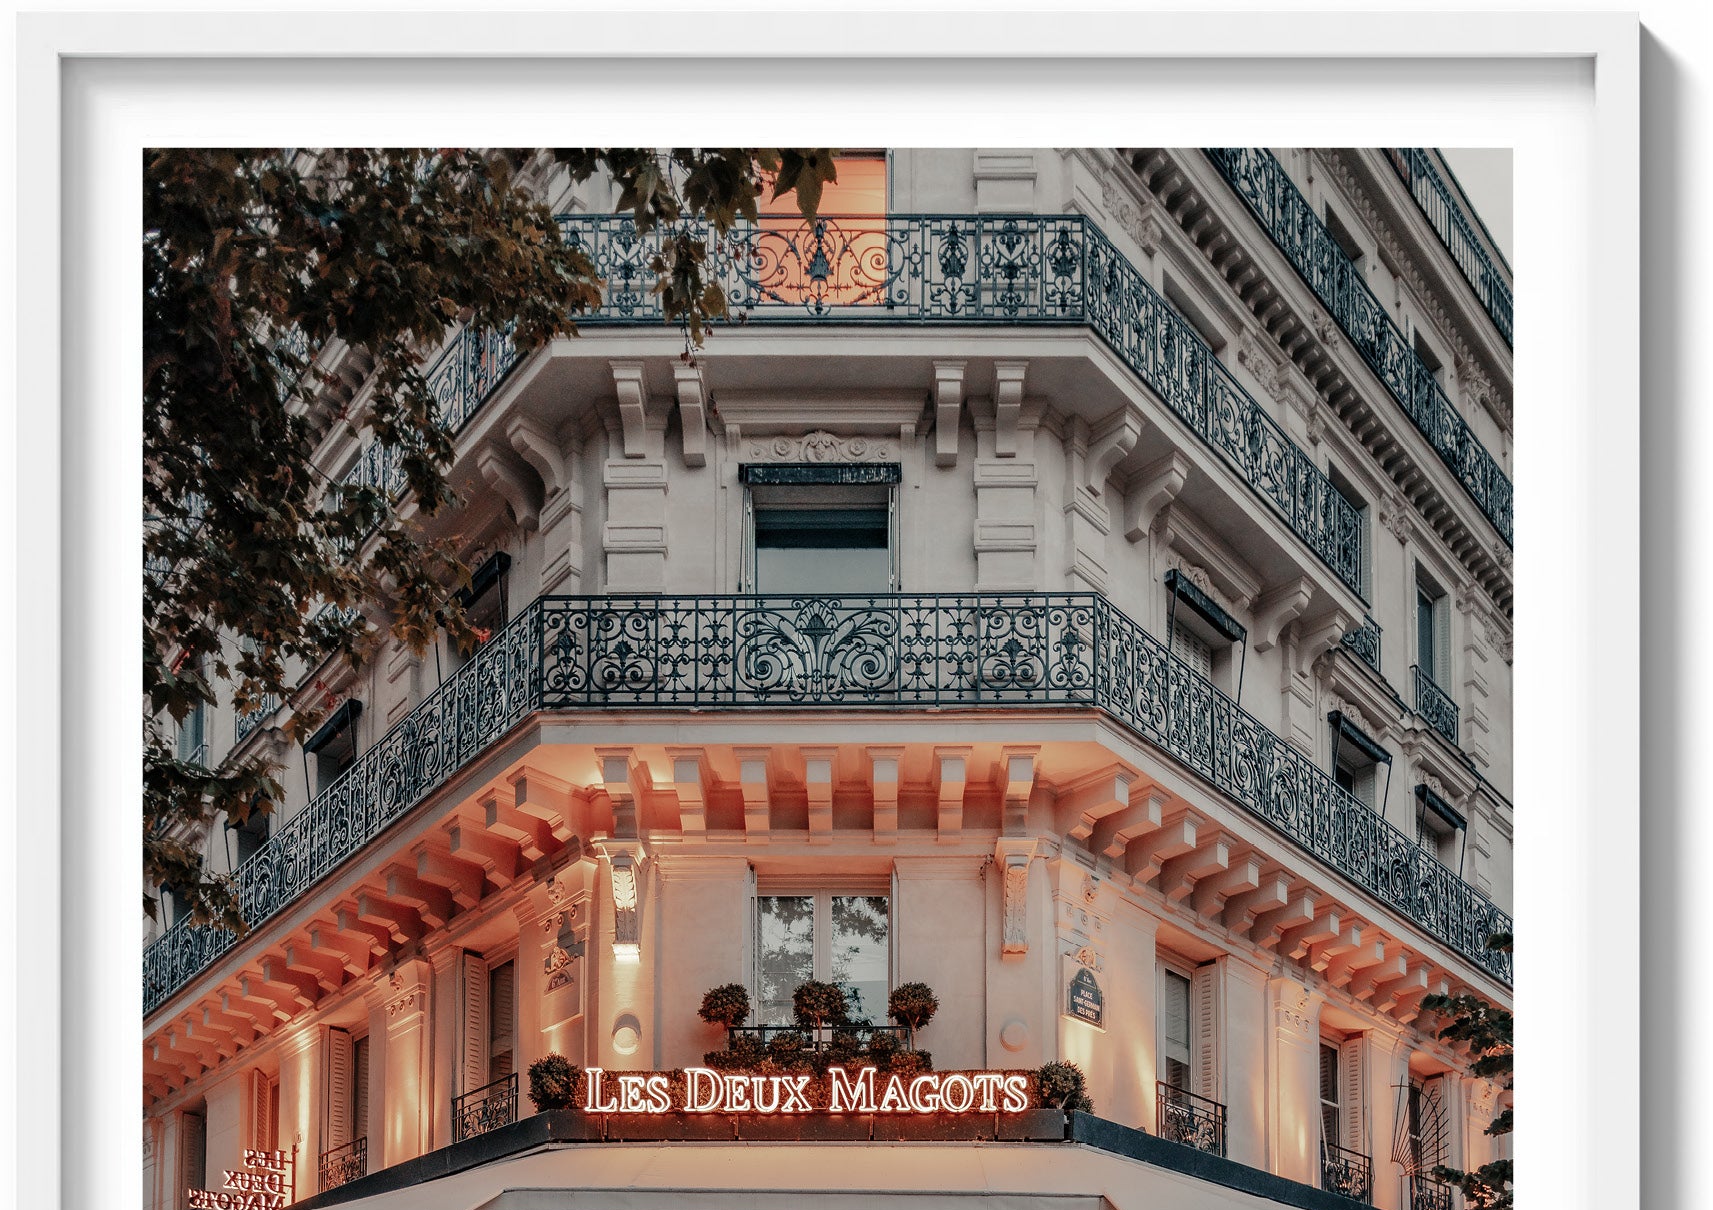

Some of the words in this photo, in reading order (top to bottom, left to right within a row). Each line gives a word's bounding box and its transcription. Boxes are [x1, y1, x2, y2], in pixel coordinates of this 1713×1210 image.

[584, 1066, 671, 1113] LES
[683, 1066, 813, 1113] DEUX
[828, 1066, 1029, 1113] MAGOTS
